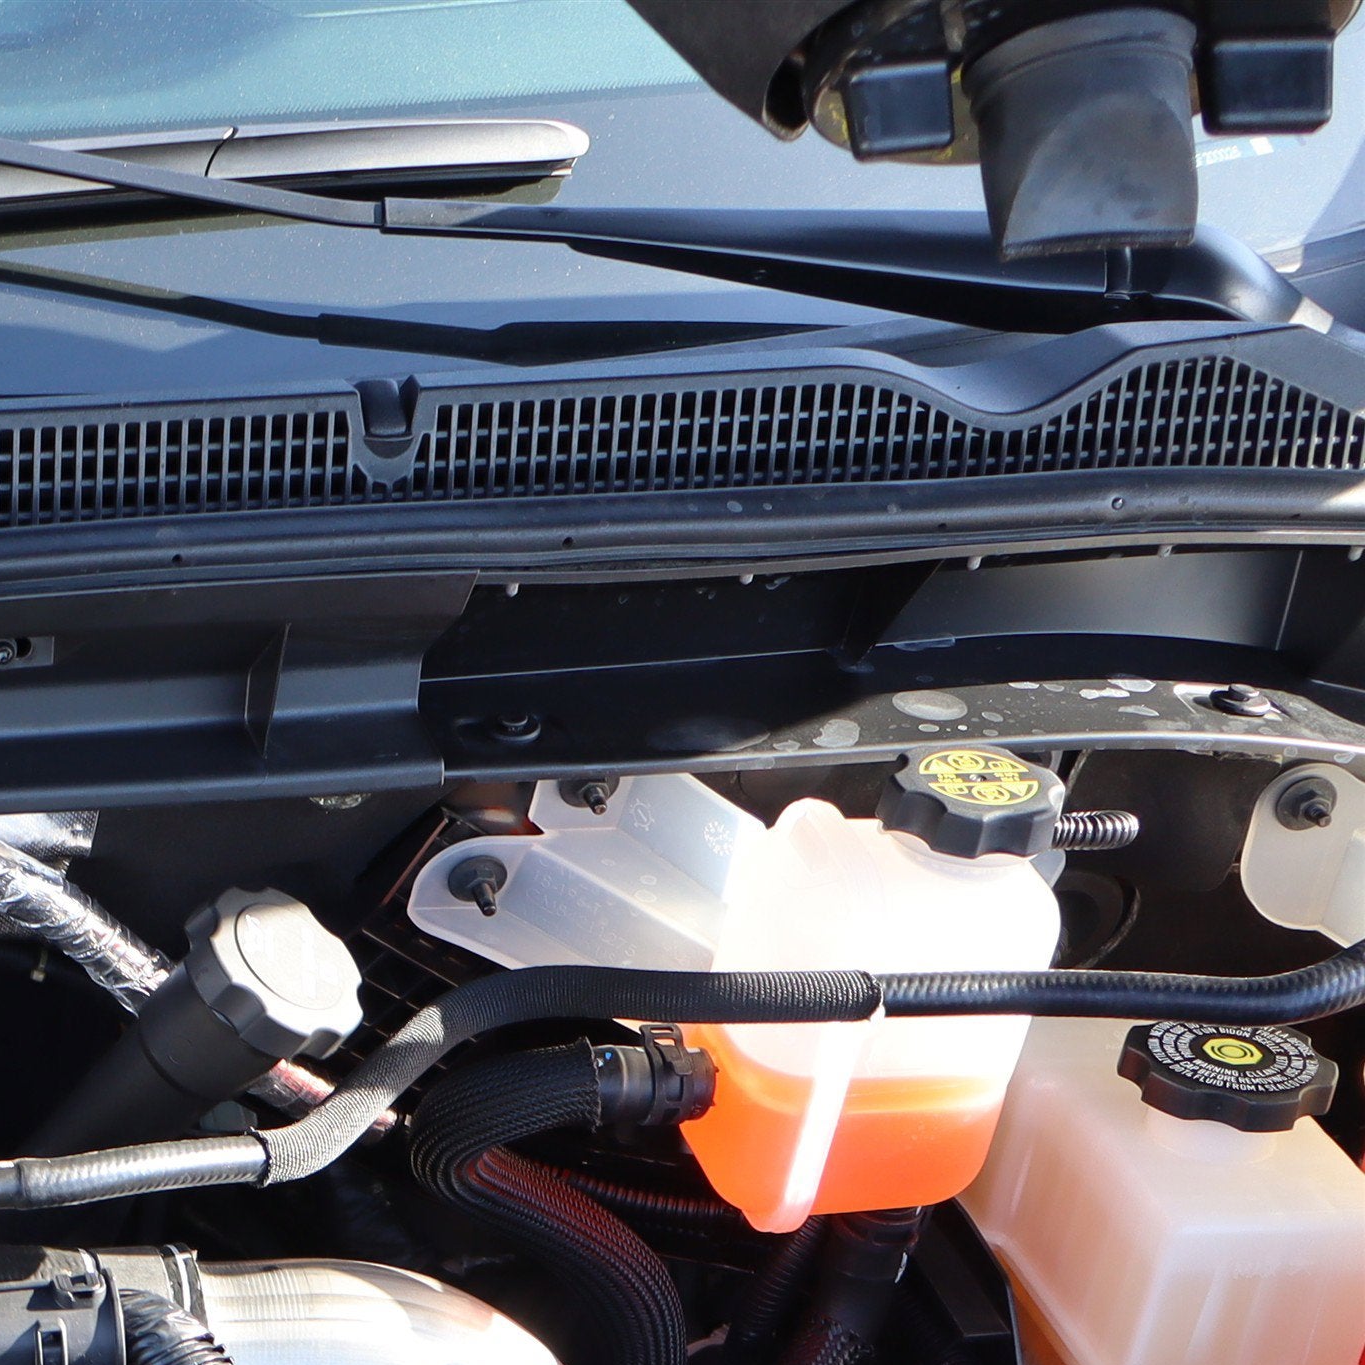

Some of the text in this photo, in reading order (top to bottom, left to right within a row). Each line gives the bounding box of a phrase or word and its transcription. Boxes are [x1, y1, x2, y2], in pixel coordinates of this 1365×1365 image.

[1219, 1028, 1250, 1037] BIDON
[1181, 1061, 1199, 1070] CAP
[1200, 1068, 1236, 1082] BEFORE
[1197, 1073, 1224, 1087] FLUID
[1226, 1081, 1257, 1091] FROM
